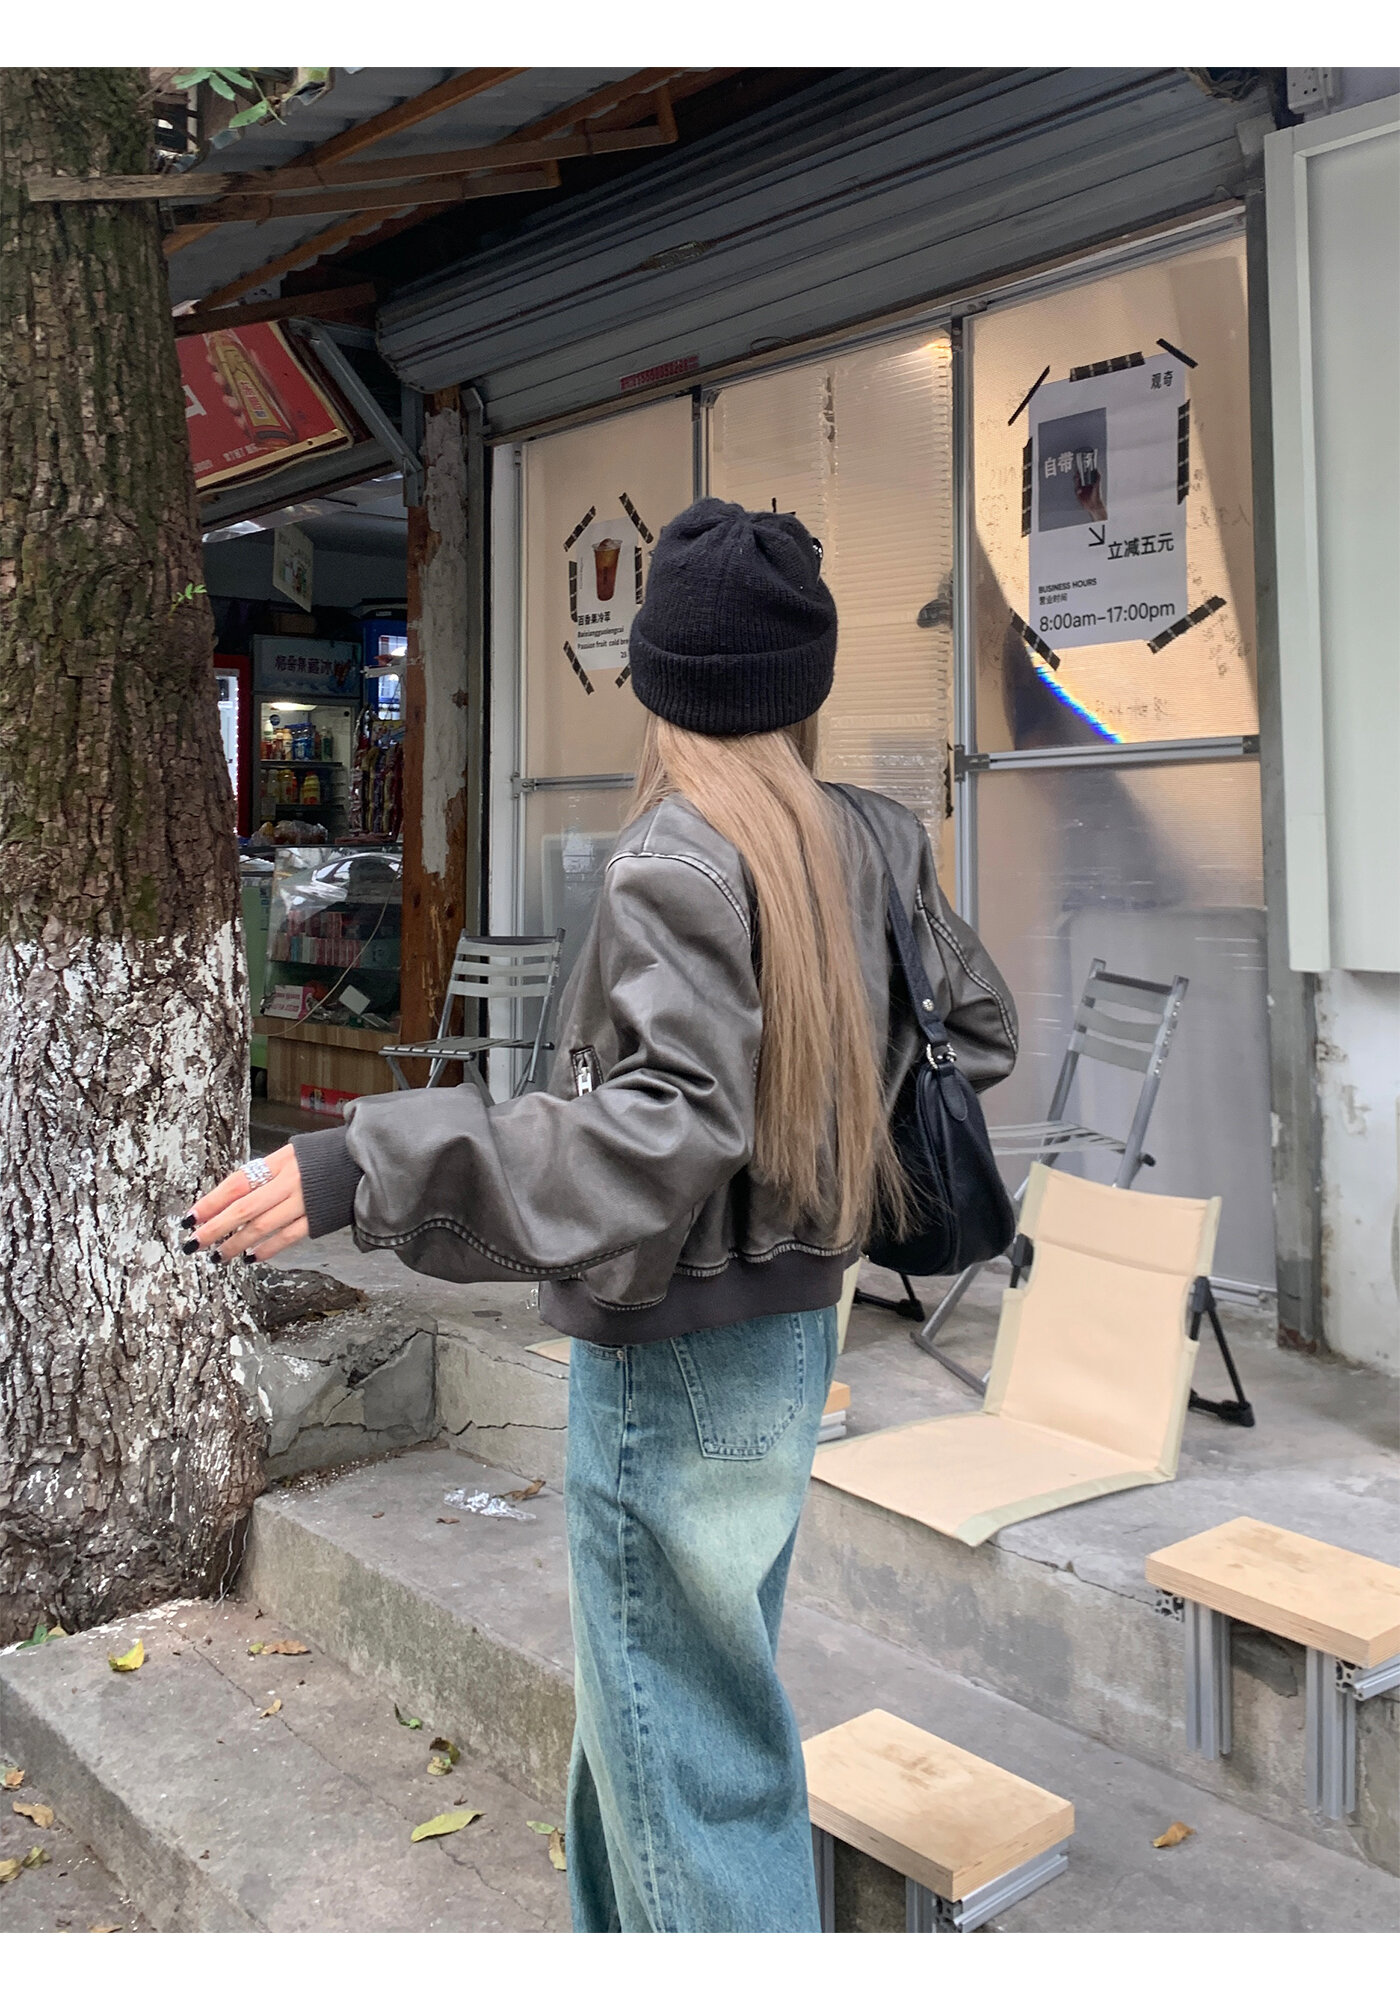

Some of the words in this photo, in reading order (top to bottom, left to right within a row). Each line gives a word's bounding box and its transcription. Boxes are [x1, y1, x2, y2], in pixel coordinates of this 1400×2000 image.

[1107, 532, 1175, 560] 立减五元
[1038, 581, 1071, 594] BUSINESS
[1072, 577, 1097, 588] HOURS
[1039, 592, 1068, 606] 营业时间
